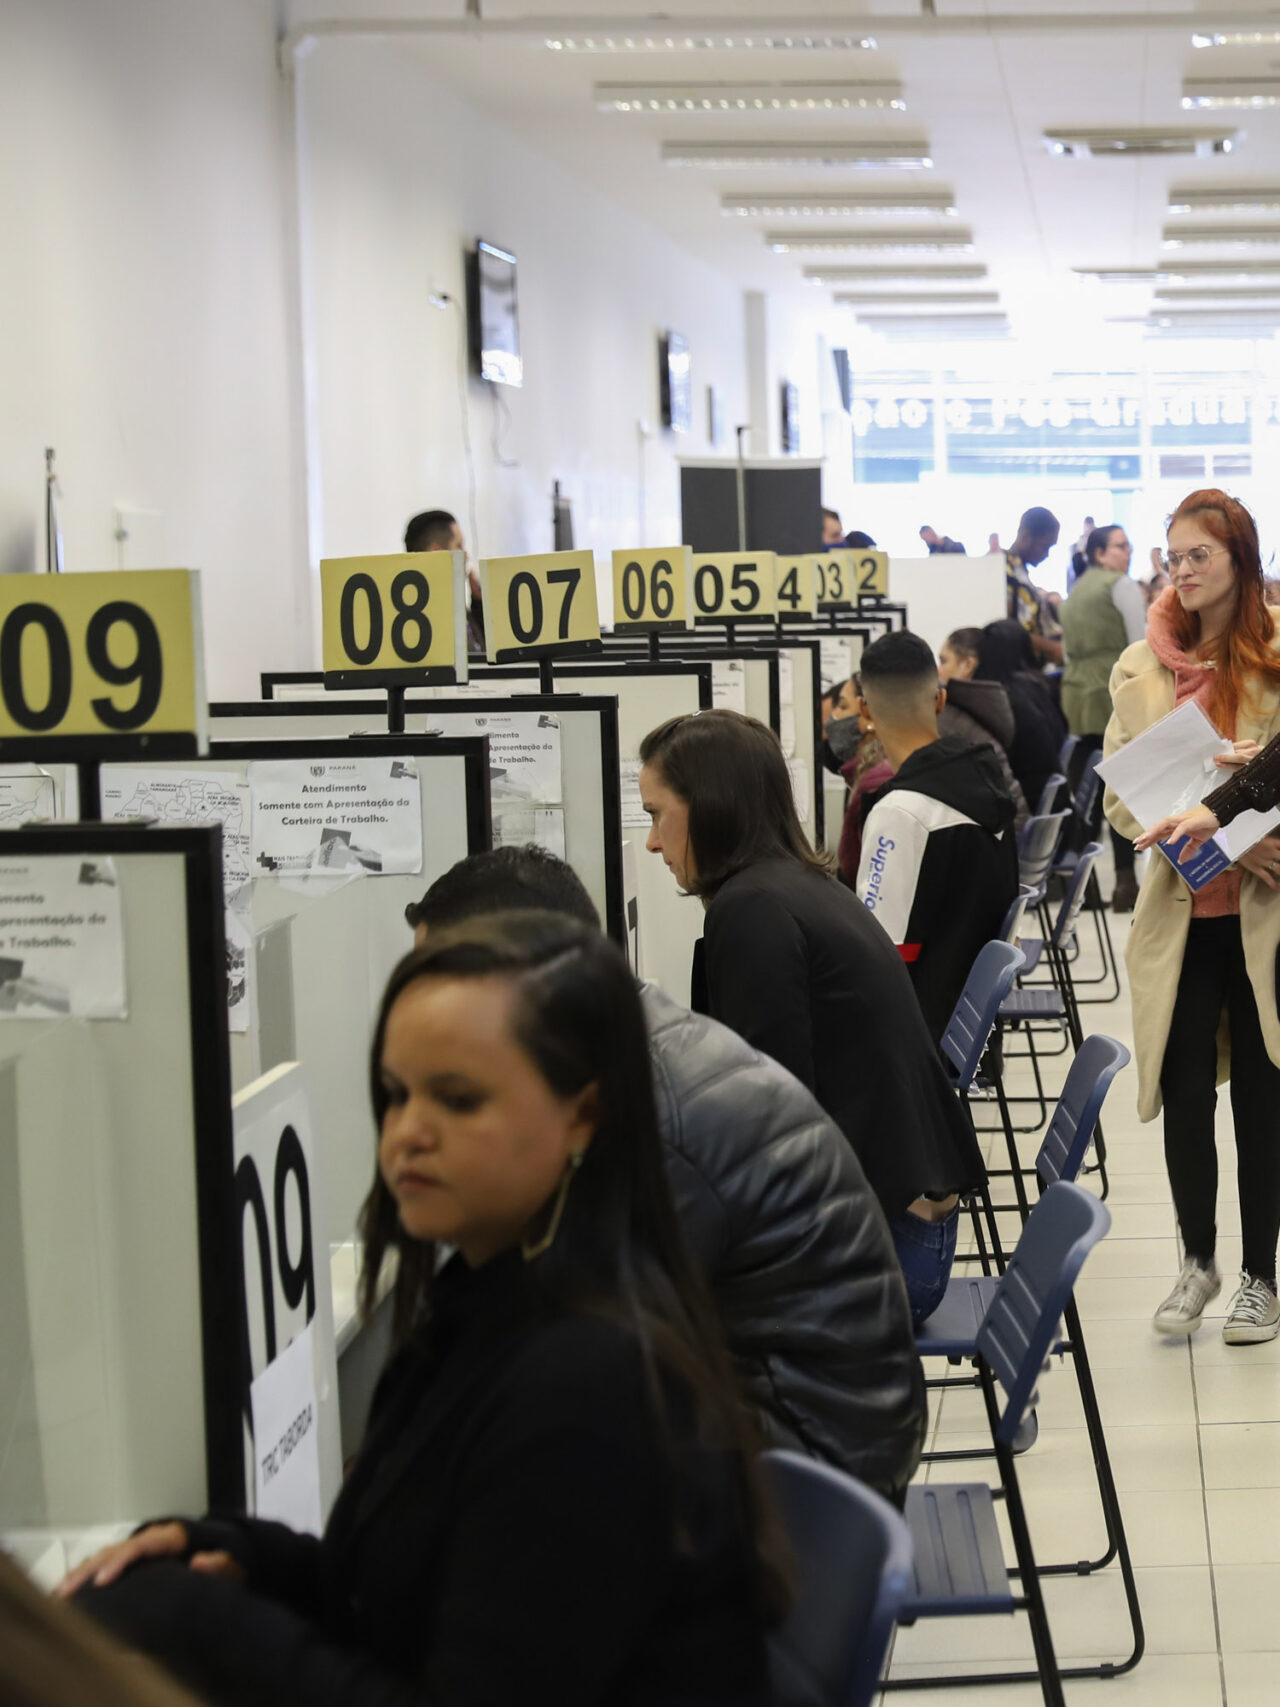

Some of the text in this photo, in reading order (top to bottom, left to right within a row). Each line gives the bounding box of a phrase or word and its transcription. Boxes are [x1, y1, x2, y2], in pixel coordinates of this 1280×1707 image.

[622, 560, 675, 620] 06
[694, 564, 760, 613] 05
[859, 558, 877, 591] 2
[340, 570, 433, 665] 08
[508, 568, 581, 644] 07
[0, 601, 163, 732] 09
[259, 802, 301, 810] Somente
[326, 799, 394, 809] Apresentação
[302, 784, 367, 793] Atendimento
[281, 814, 388, 825] Carteira de Trabalho.
